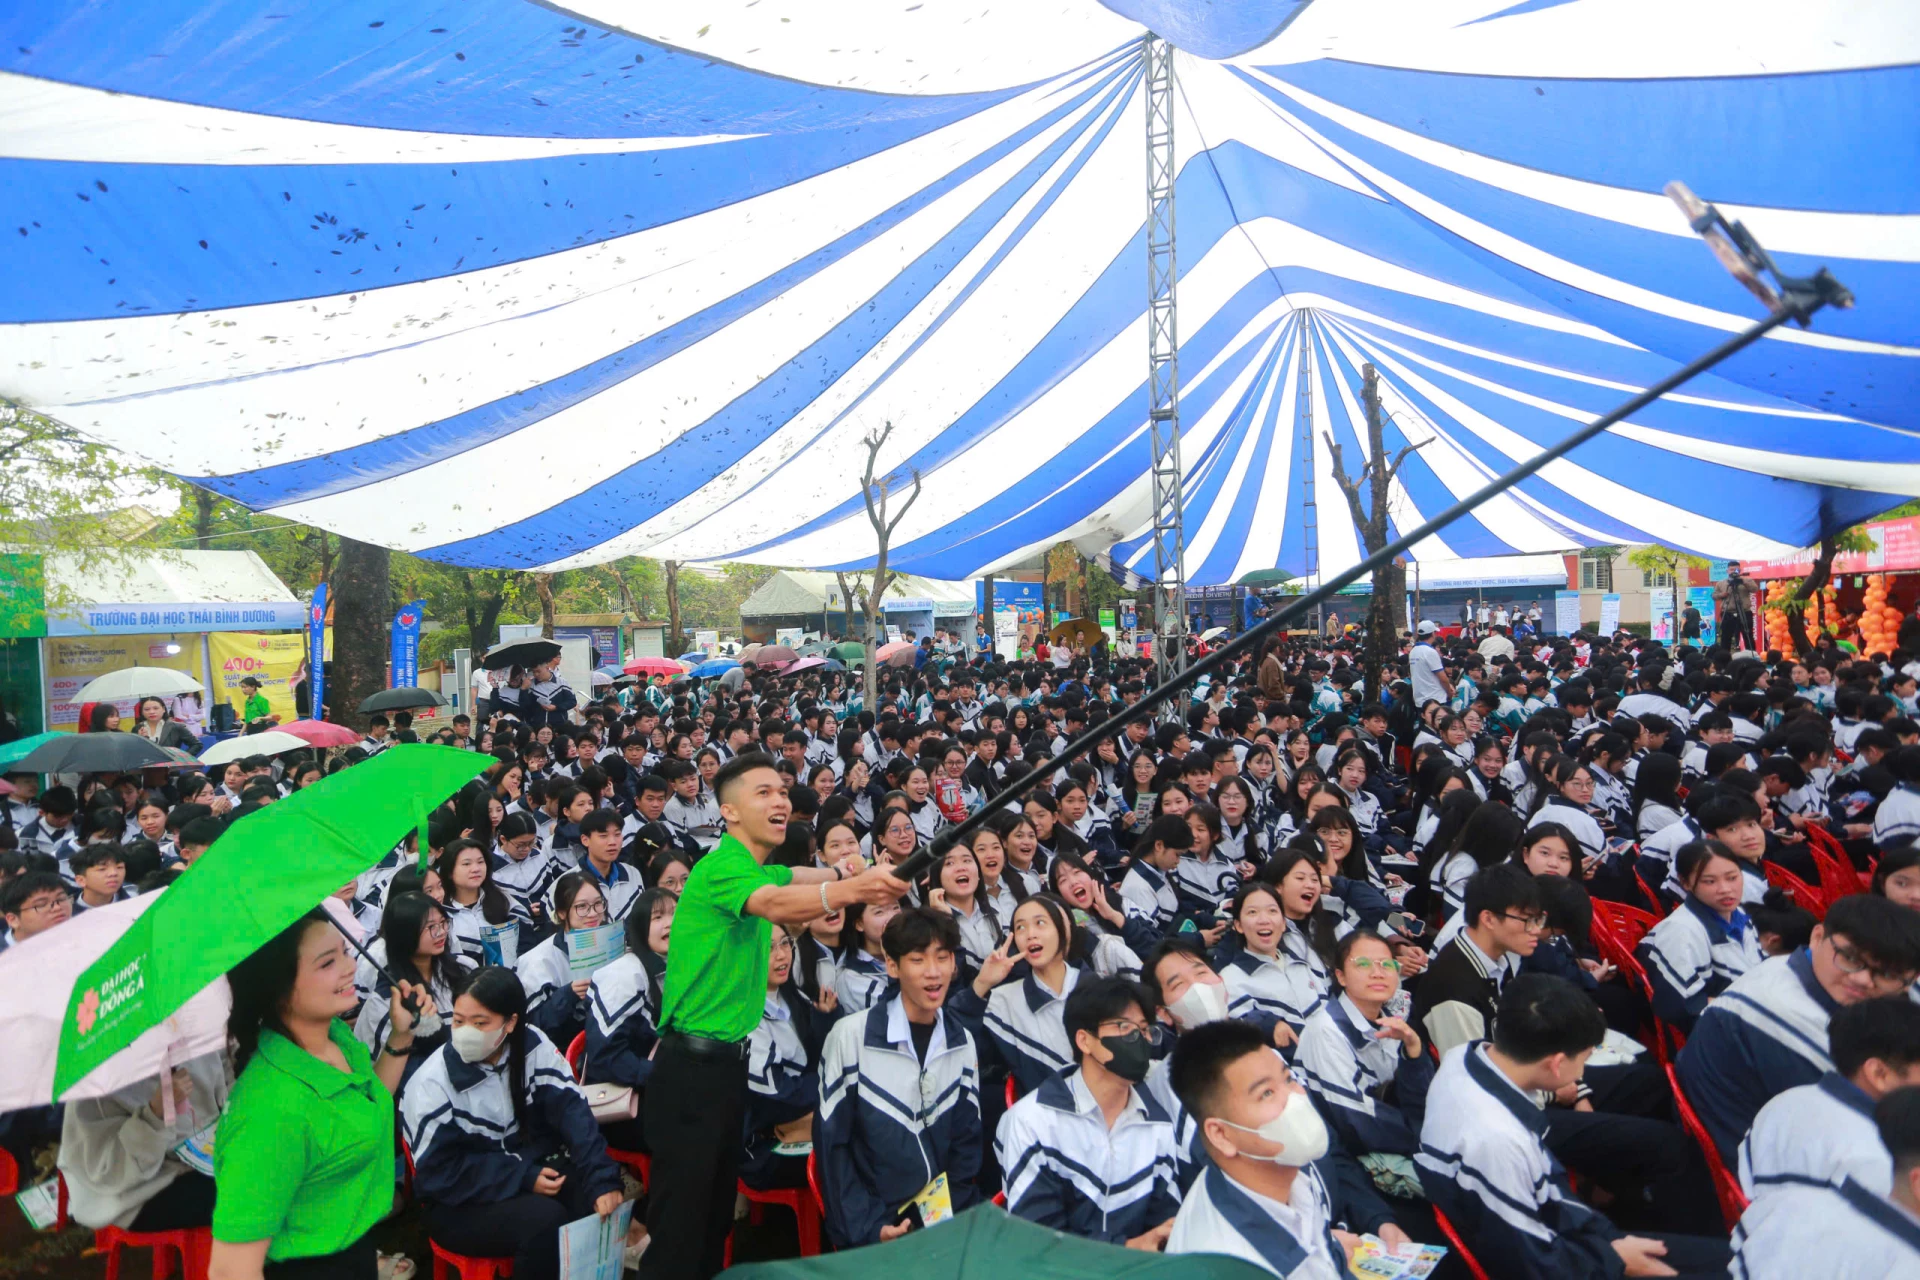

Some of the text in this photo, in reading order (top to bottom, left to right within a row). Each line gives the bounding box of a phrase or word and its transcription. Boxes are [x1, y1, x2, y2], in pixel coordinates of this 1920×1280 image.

[89, 608, 276, 628] TRƯỜNG ĐẠI HỌC THÁI BÌNH DƯƠNG
[223, 657, 264, 671] 400+
[101, 973, 118, 996] ĐẠI
[100, 980, 136, 1019] ĐÔNG
